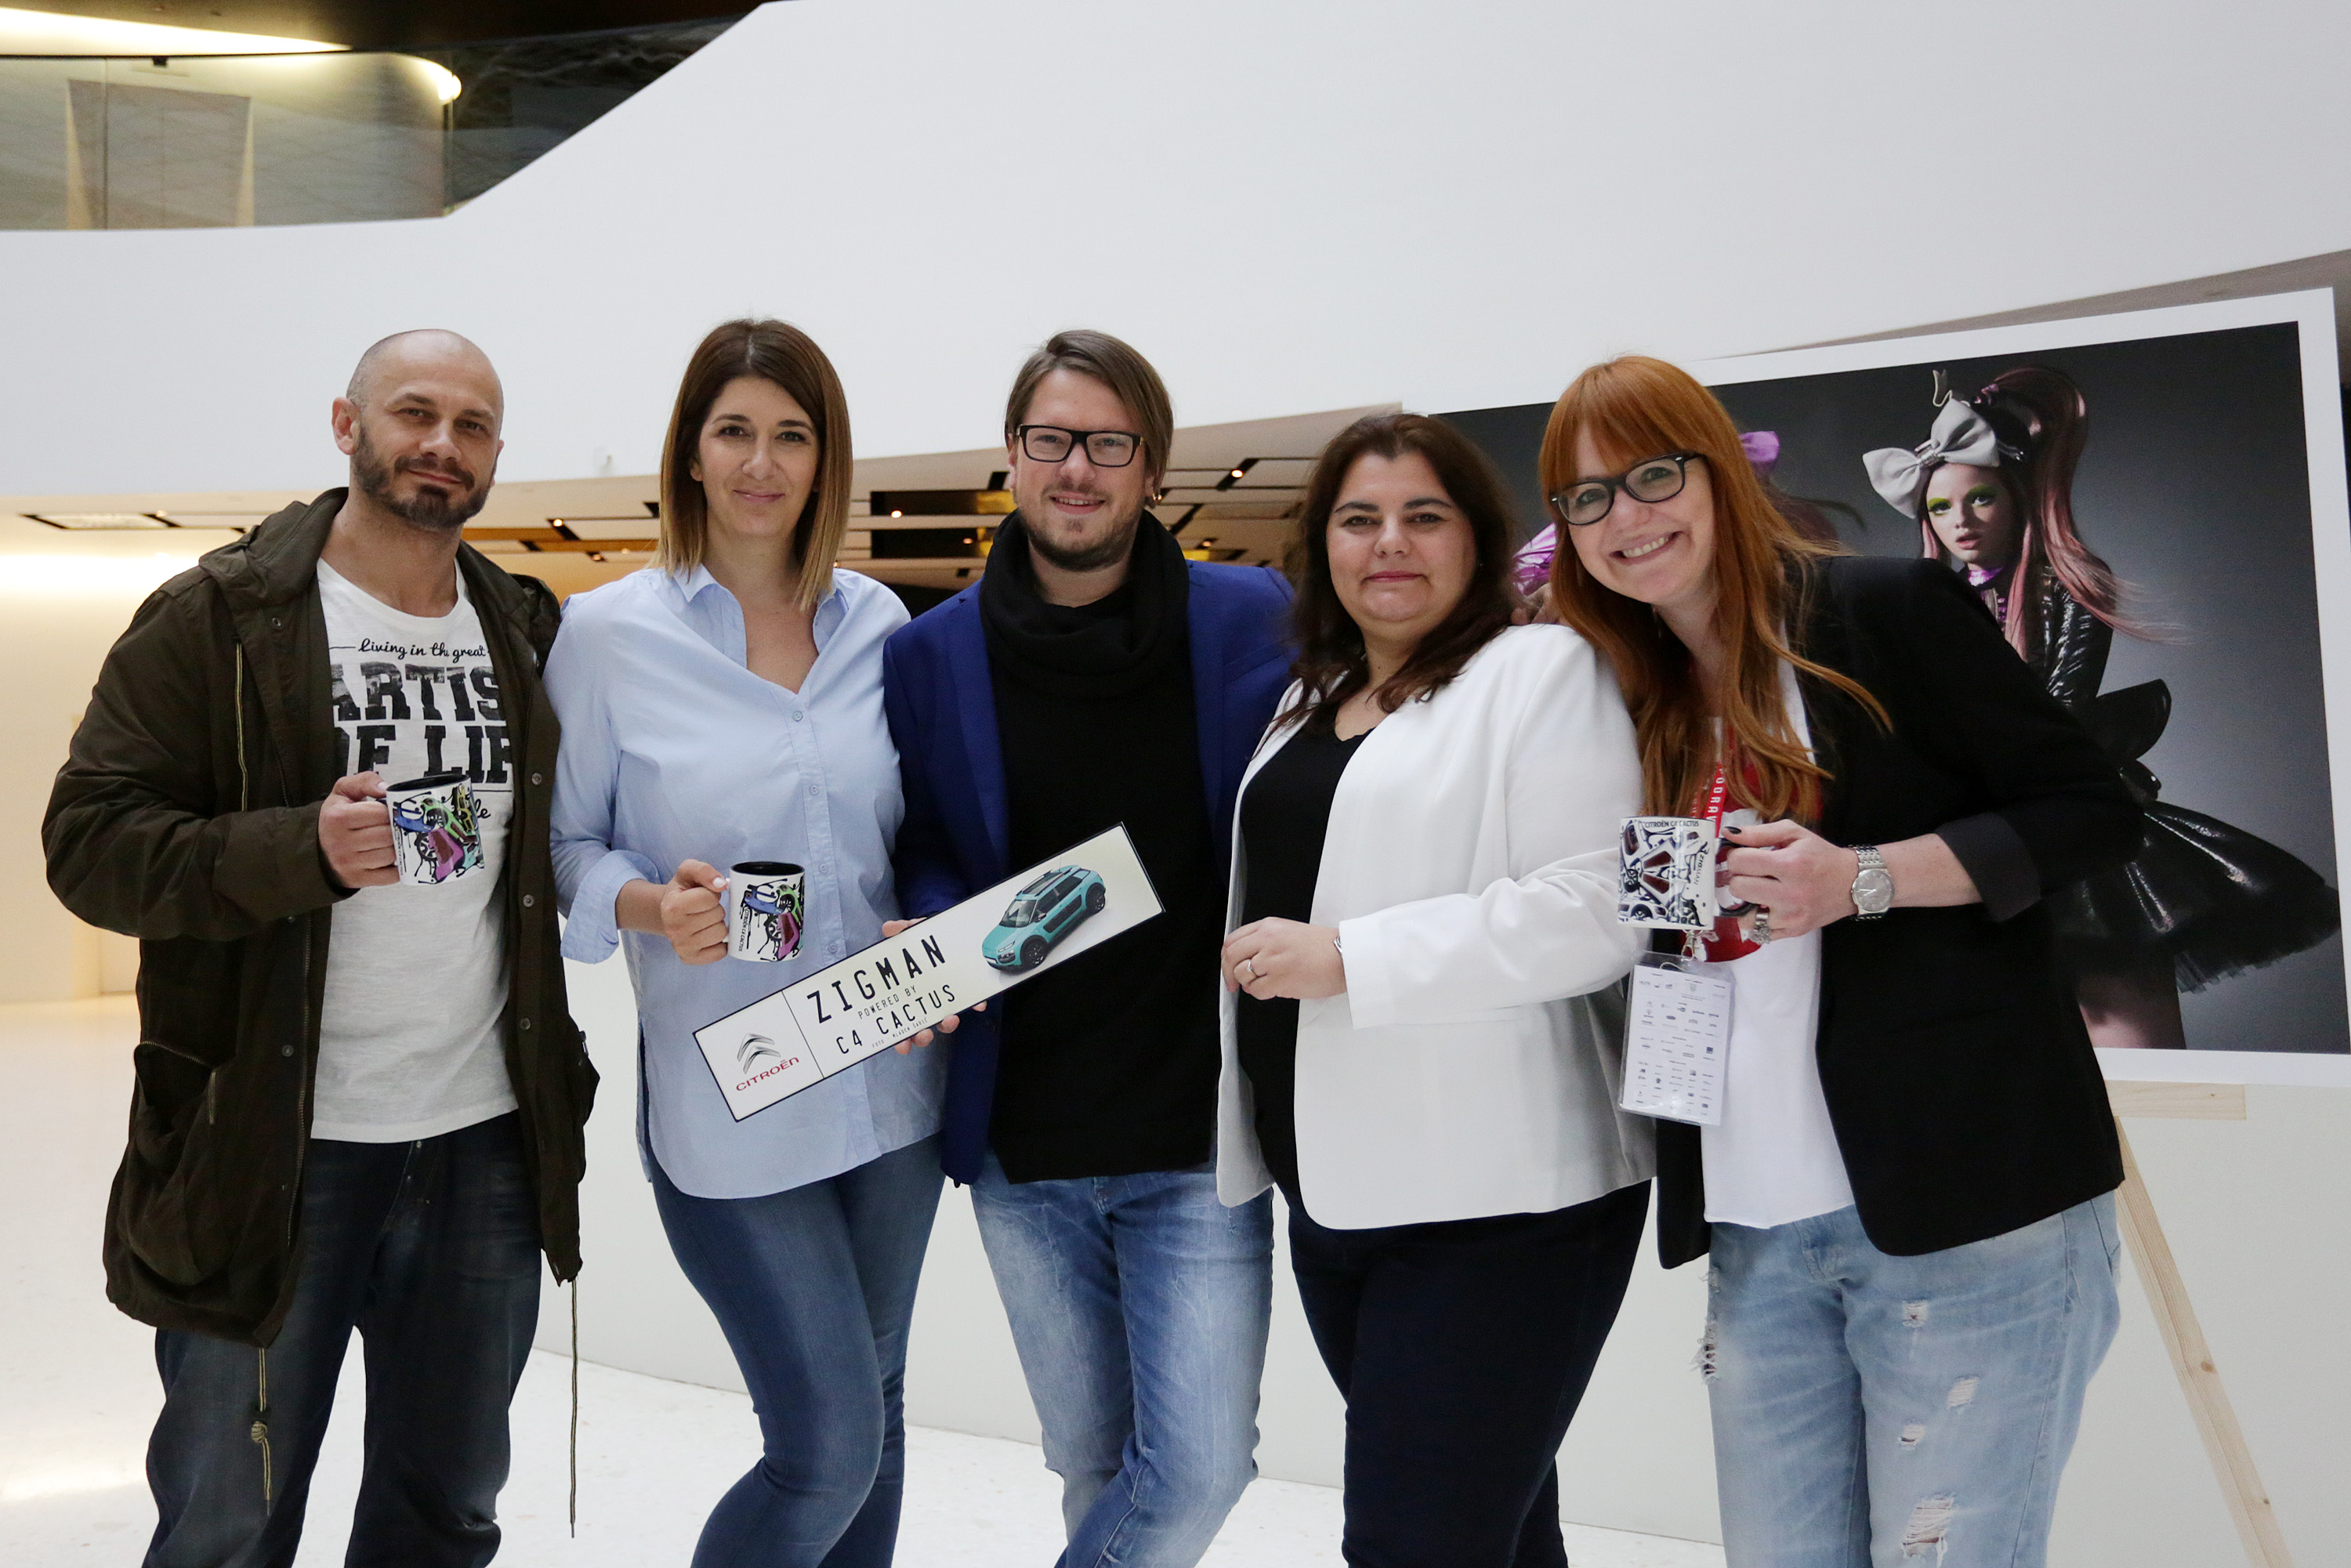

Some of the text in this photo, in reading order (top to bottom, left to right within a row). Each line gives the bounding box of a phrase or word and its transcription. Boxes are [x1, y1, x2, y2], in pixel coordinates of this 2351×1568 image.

[358, 638, 408, 660] Living
[410, 644, 428, 656] in
[452, 644, 487, 664] great
[807, 935, 945, 1023] ZIGMAN
[836, 984, 955, 1054] C4 CACTUS
[858, 985, 916, 1019] POWERED BY
[736, 1057, 799, 1091] CITROËN
